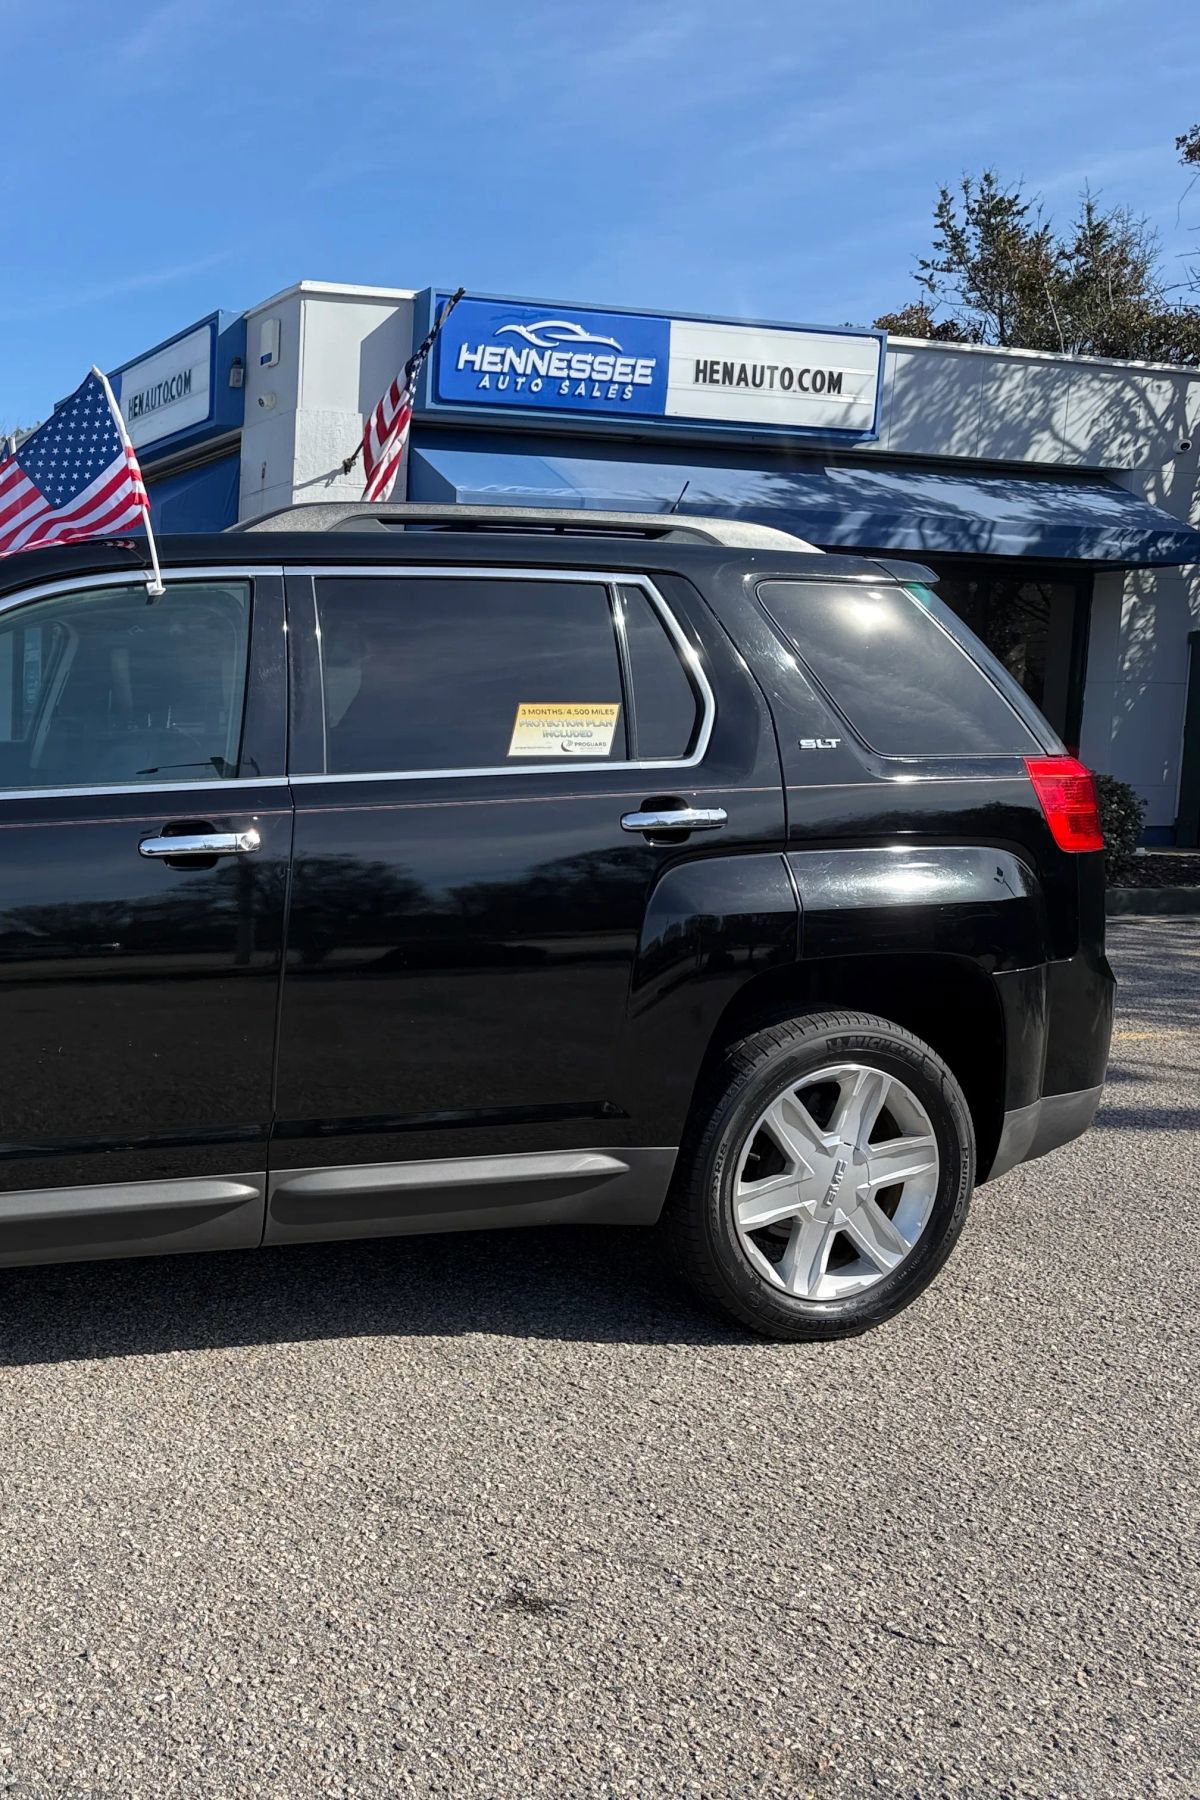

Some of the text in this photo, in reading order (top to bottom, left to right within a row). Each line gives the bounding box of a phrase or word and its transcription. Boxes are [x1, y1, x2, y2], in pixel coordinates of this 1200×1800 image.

[457, 342, 656, 385] HENNESSEE
[478, 374, 634, 400] AUTO SALES
[694, 359, 843, 395] HENAUTO.COM
[128, 368, 192, 422] HENAUTO.COM
[519, 719, 613, 729] PROTECTION PLAN
[591, 708, 615, 716] MILES
[542, 729, 593, 739] INCLUDED
[799, 738, 842, 750] SLT
[822, 1158, 848, 1206] GMC
